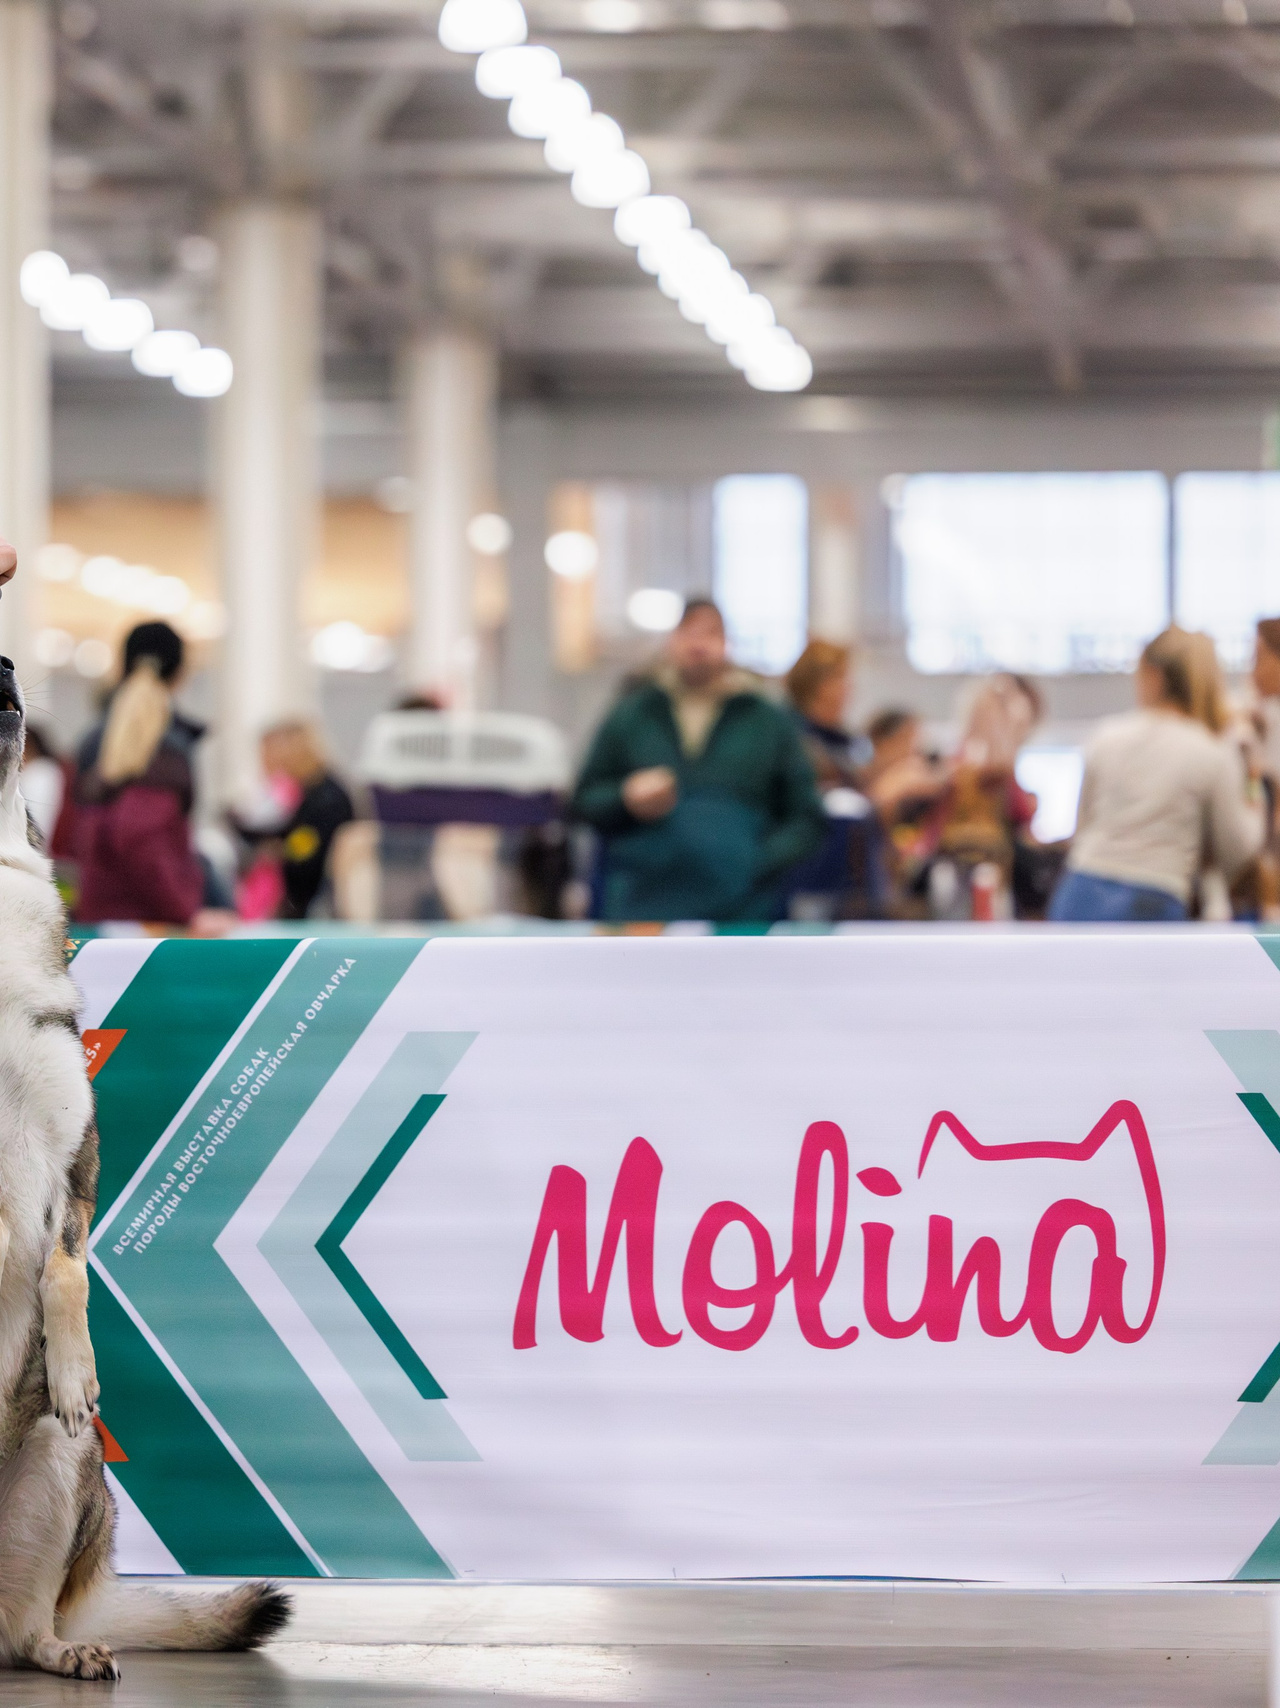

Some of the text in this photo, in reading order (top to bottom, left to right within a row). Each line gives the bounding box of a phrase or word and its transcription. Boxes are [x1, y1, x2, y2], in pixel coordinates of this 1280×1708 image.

[112, 1047, 270, 1256] ВСЕМИРНАЯ ВЫСТАВКА СОБАК
[133, 957, 357, 1254] ПОРОДЫ ВОСТОЧНОЕВРОПЕЙСКАЯ ОВЧАРКА
[512, 1099, 1166, 1354] Molina
